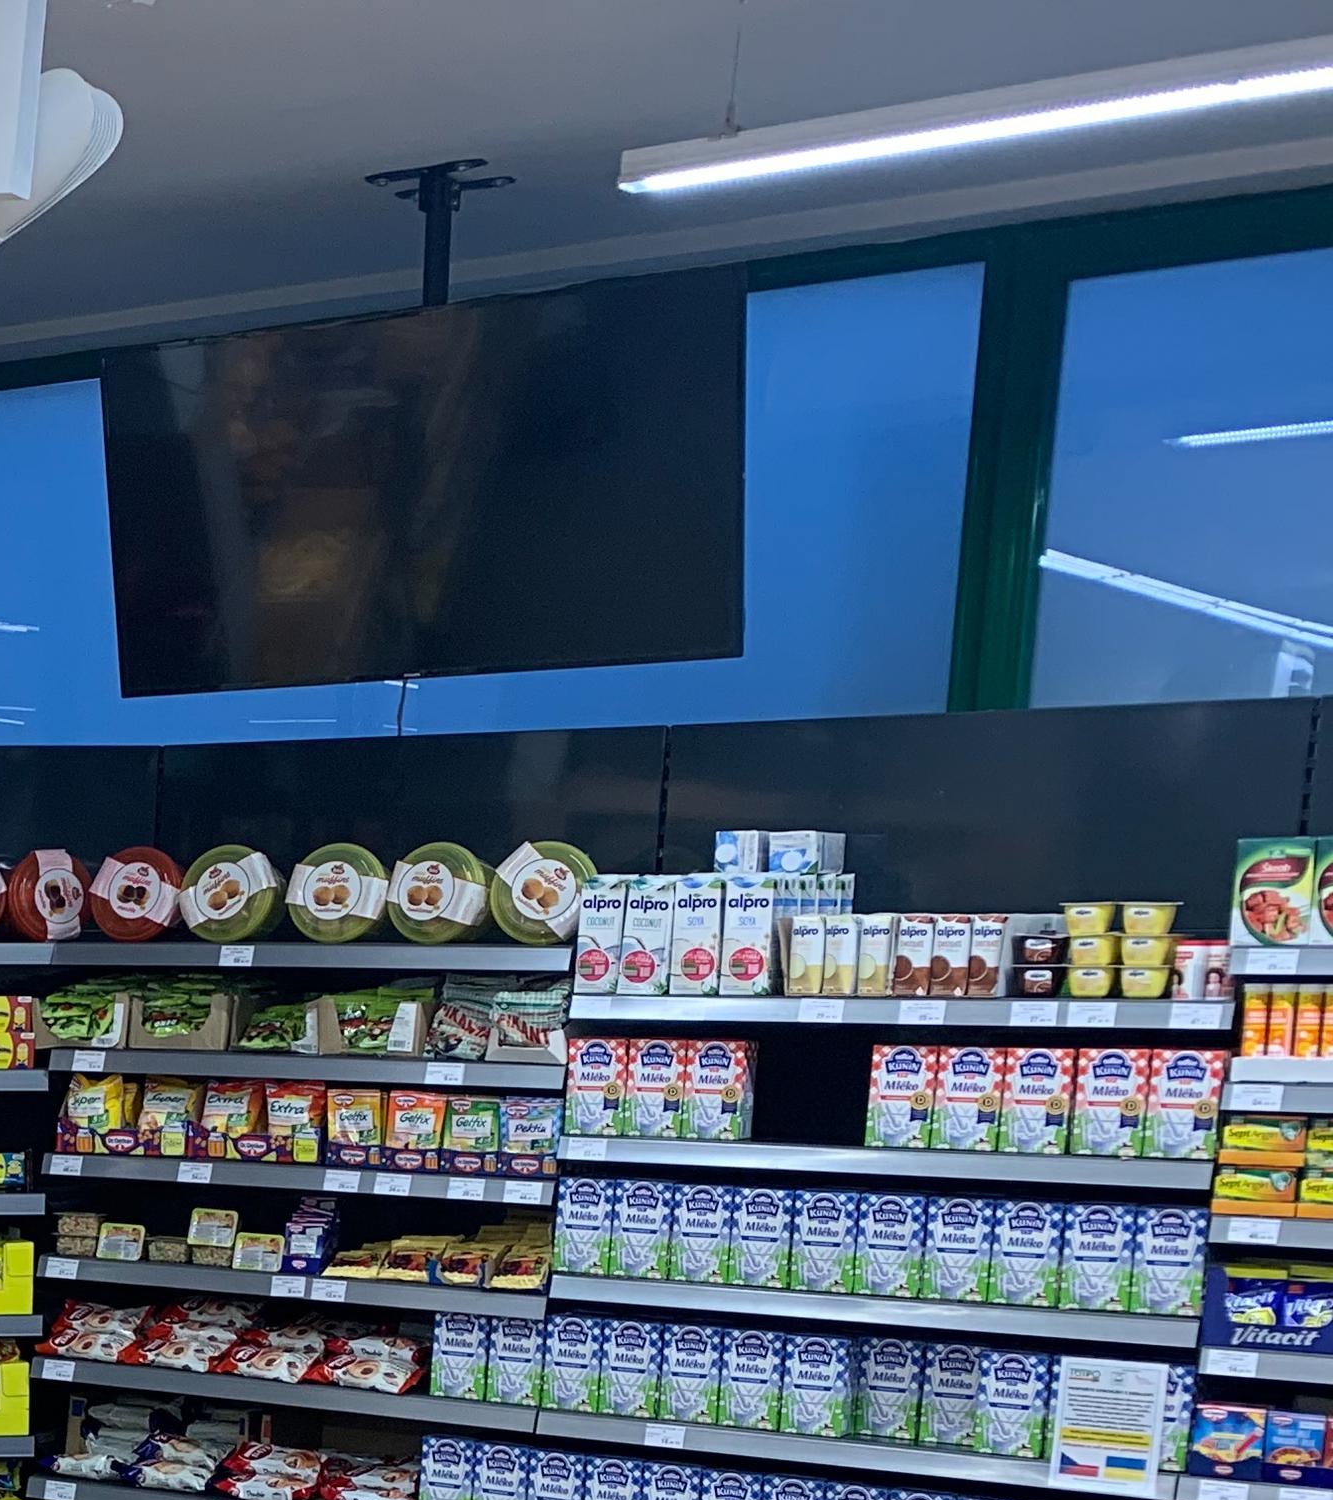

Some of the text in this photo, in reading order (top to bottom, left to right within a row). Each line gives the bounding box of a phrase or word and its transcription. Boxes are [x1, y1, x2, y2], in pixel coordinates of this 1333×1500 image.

[583, 896, 621, 912] alpro
[629, 897, 669, 913] alpro
[678, 895, 717, 911] alpro
[728, 895, 769, 911] alpro
[793, 927, 819, 938] alpro
[863, 926, 890, 937] alpro
[900, 927, 927, 938] alpro
[937, 927, 965, 938] alpro
[975, 926, 1002, 938] alpro
[270, 1102, 306, 1114] Extra
[399, 1112, 430, 1125] Gelfix
[456, 1117, 487, 1128] Gelfix
[1231, 1326, 1320, 1346] Vitacit
